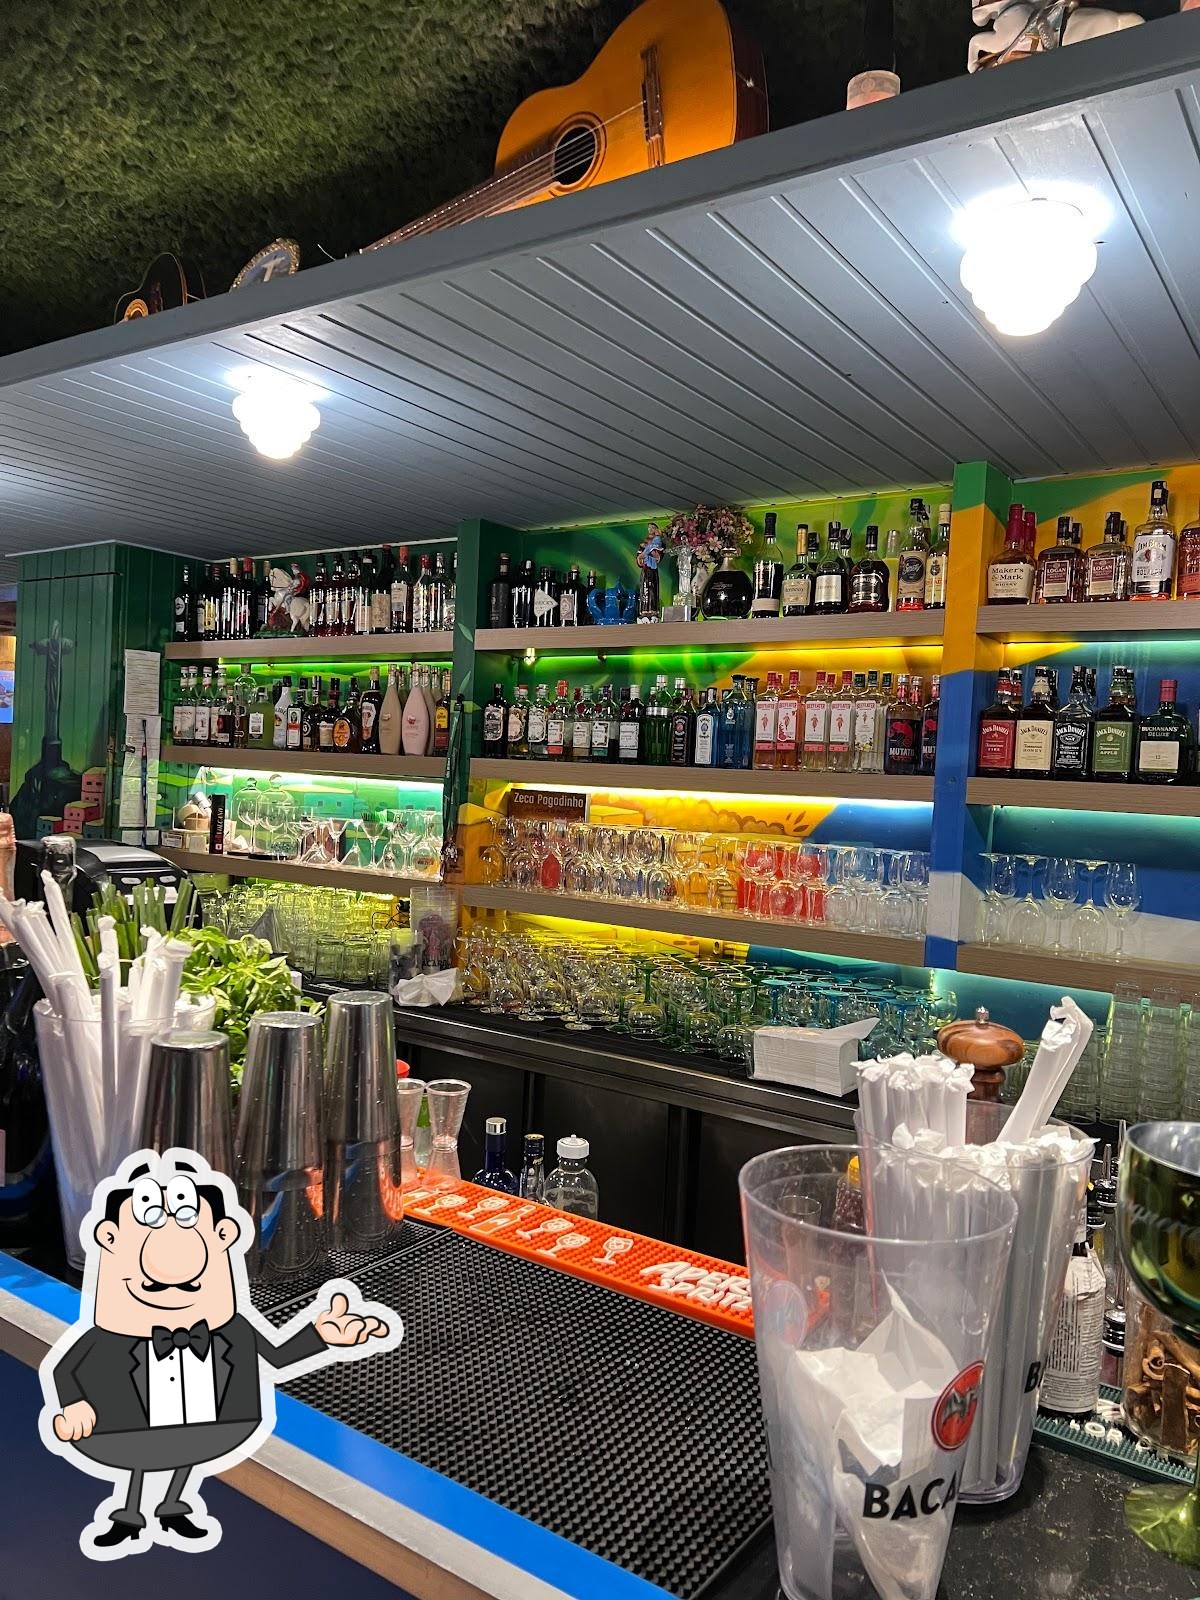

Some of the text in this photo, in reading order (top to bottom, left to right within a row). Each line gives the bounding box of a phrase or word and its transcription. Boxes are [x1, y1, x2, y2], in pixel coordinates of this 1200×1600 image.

[1093, 564, 1113, 572] LOGAN
[513, 792, 584, 808] Zeca Pagodinho
[639, 1260, 751, 1296] APER
